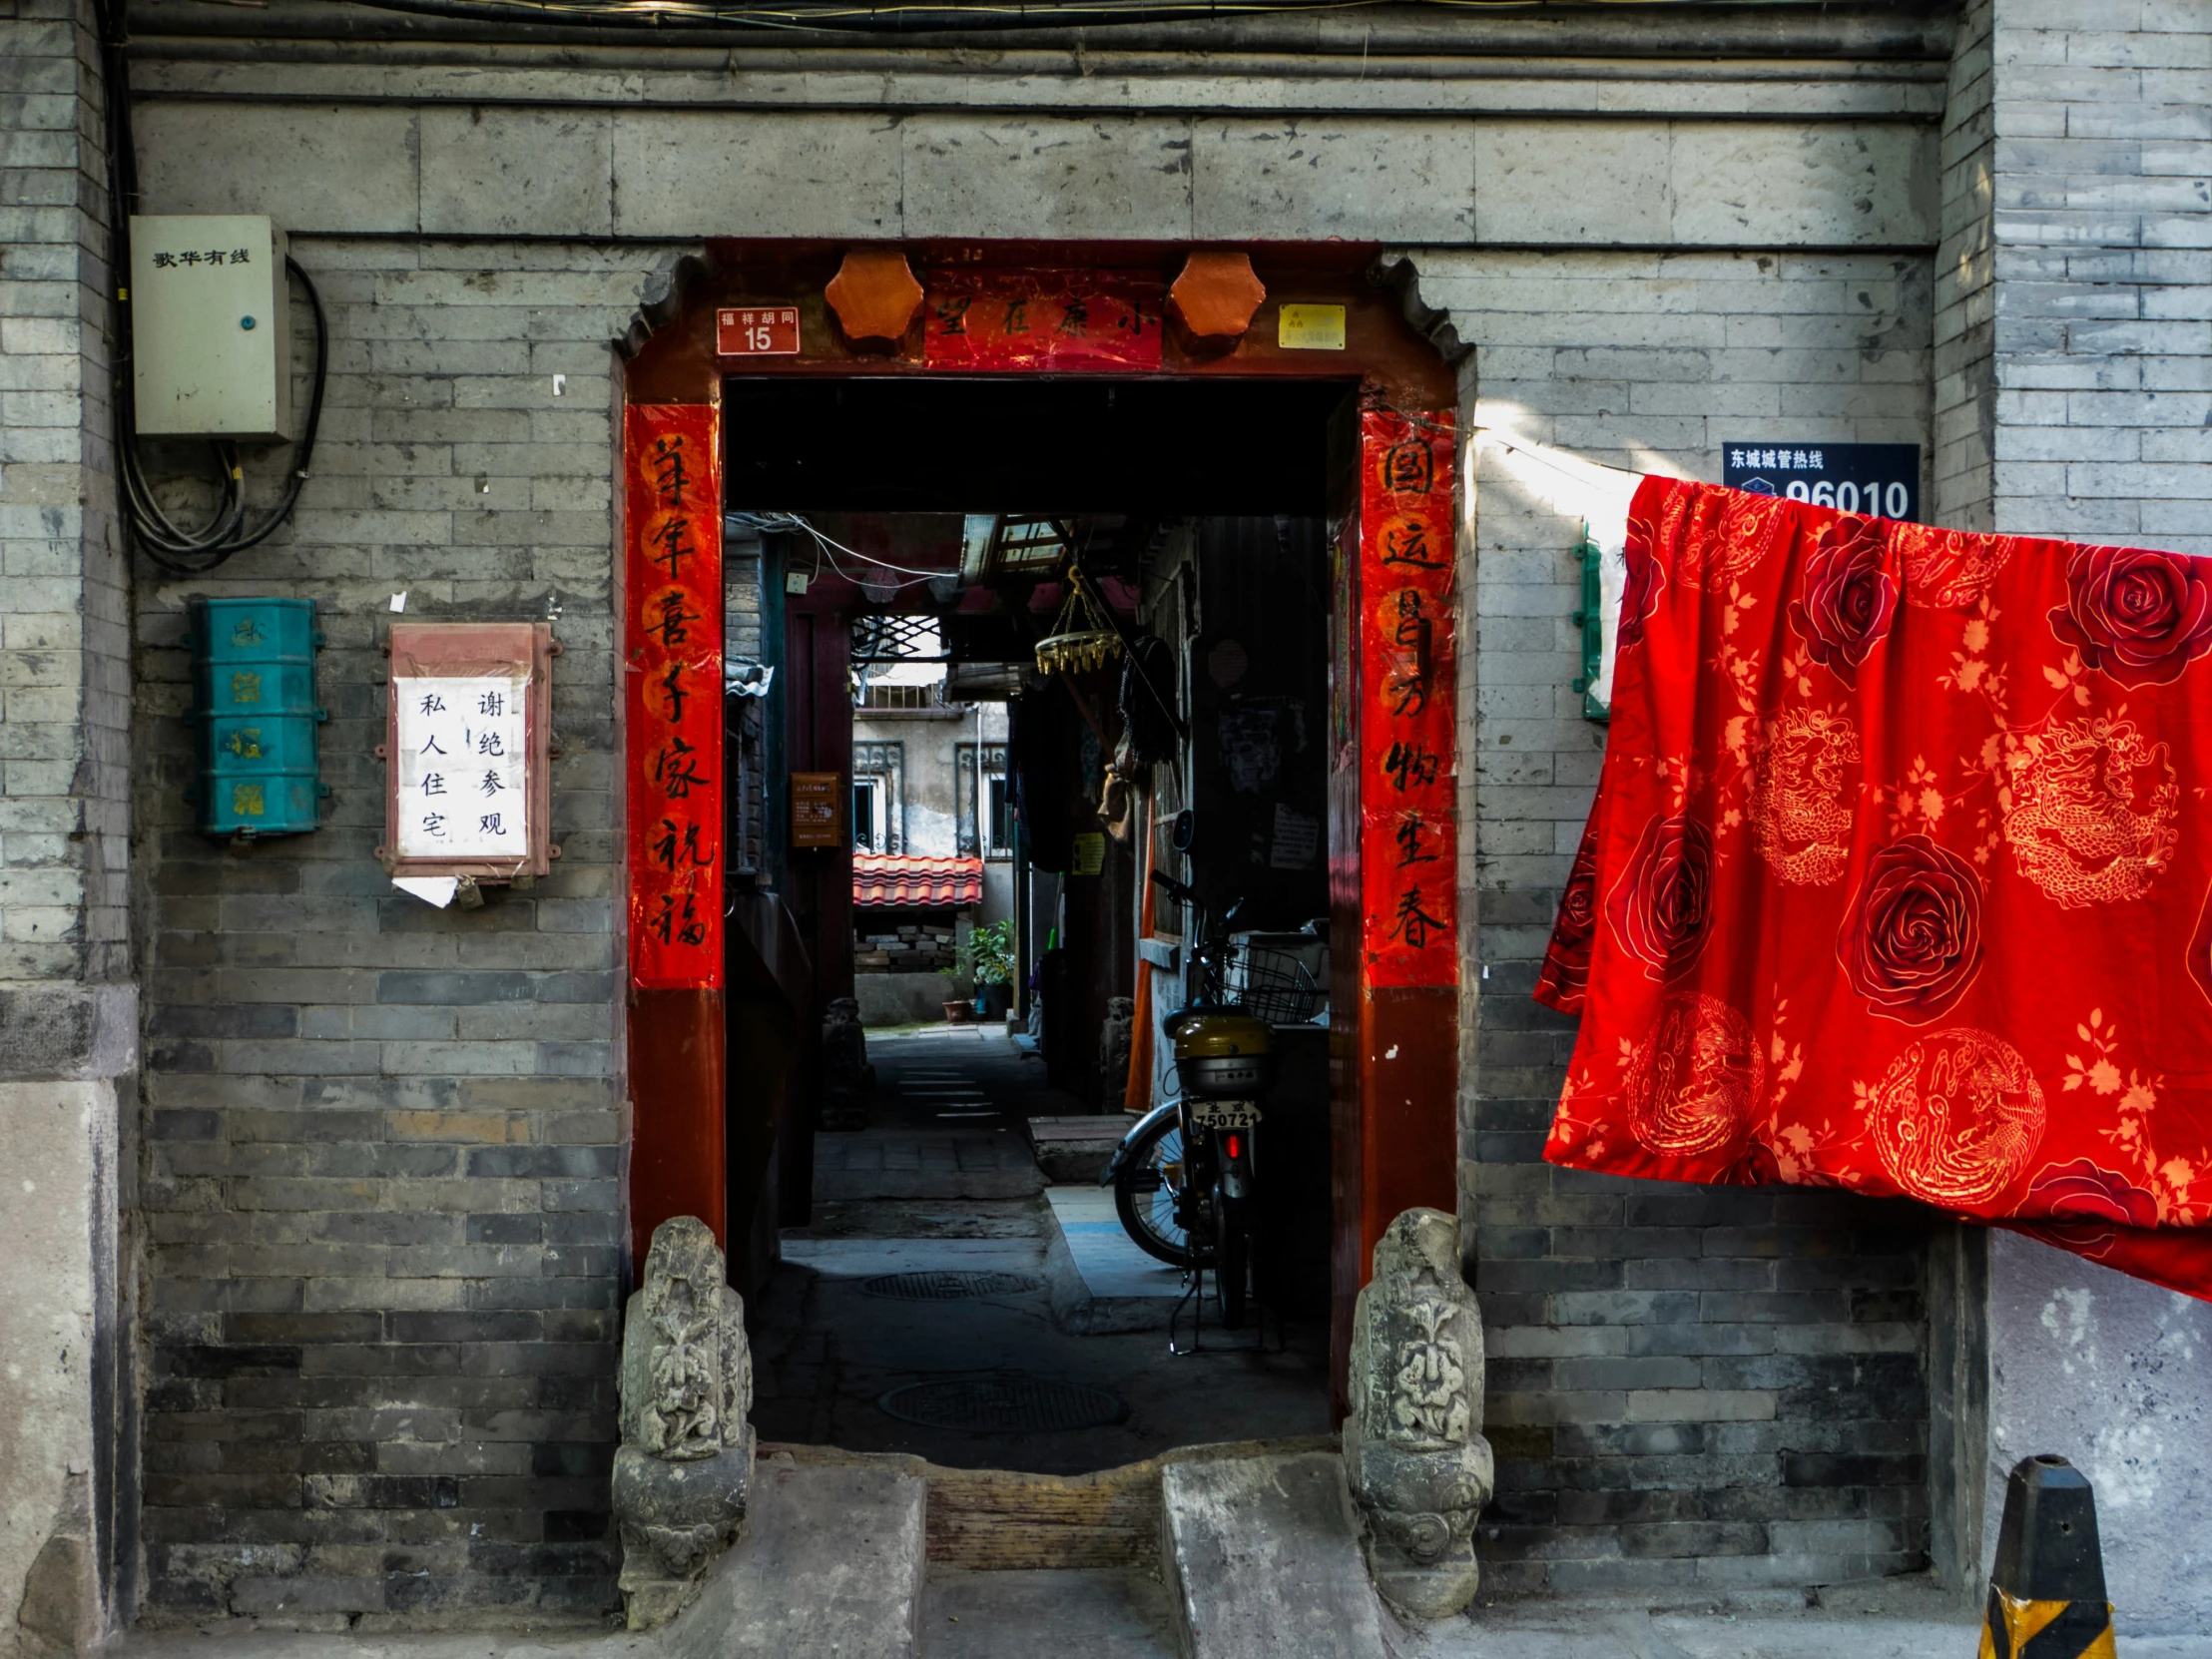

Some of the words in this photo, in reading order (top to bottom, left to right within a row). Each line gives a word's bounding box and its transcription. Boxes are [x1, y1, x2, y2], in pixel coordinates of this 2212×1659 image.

[153, 249, 251, 269] 歌华有线
[721, 311, 795, 326] 福祥胡同
[745, 326, 772, 350] 15
[1731, 449, 1825, 470] 东城城管热线
[419, 694, 448, 837] 私人住宅
[477, 691, 507, 836] 谢绝参观
[1207, 1100, 1247, 1113] 北京
[1198, 1112, 1258, 1128] 750721
